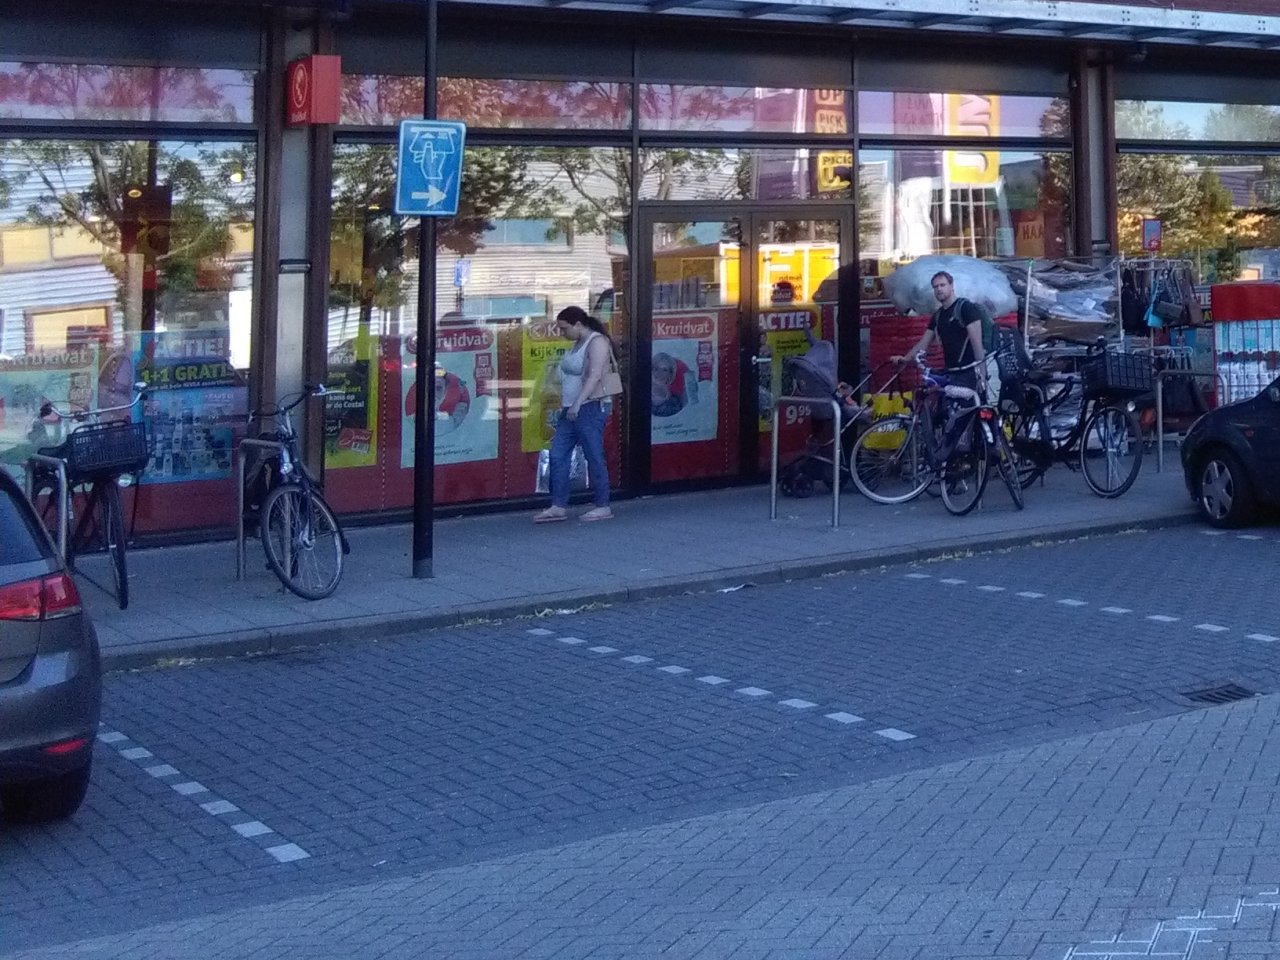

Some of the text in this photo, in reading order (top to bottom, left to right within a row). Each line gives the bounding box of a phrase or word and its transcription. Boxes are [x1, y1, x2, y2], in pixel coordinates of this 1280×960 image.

[657, 321, 709, 334] Kruidvat
[759, 312, 811, 330] ACTIE!
[436, 333, 489, 348] ruidvat
